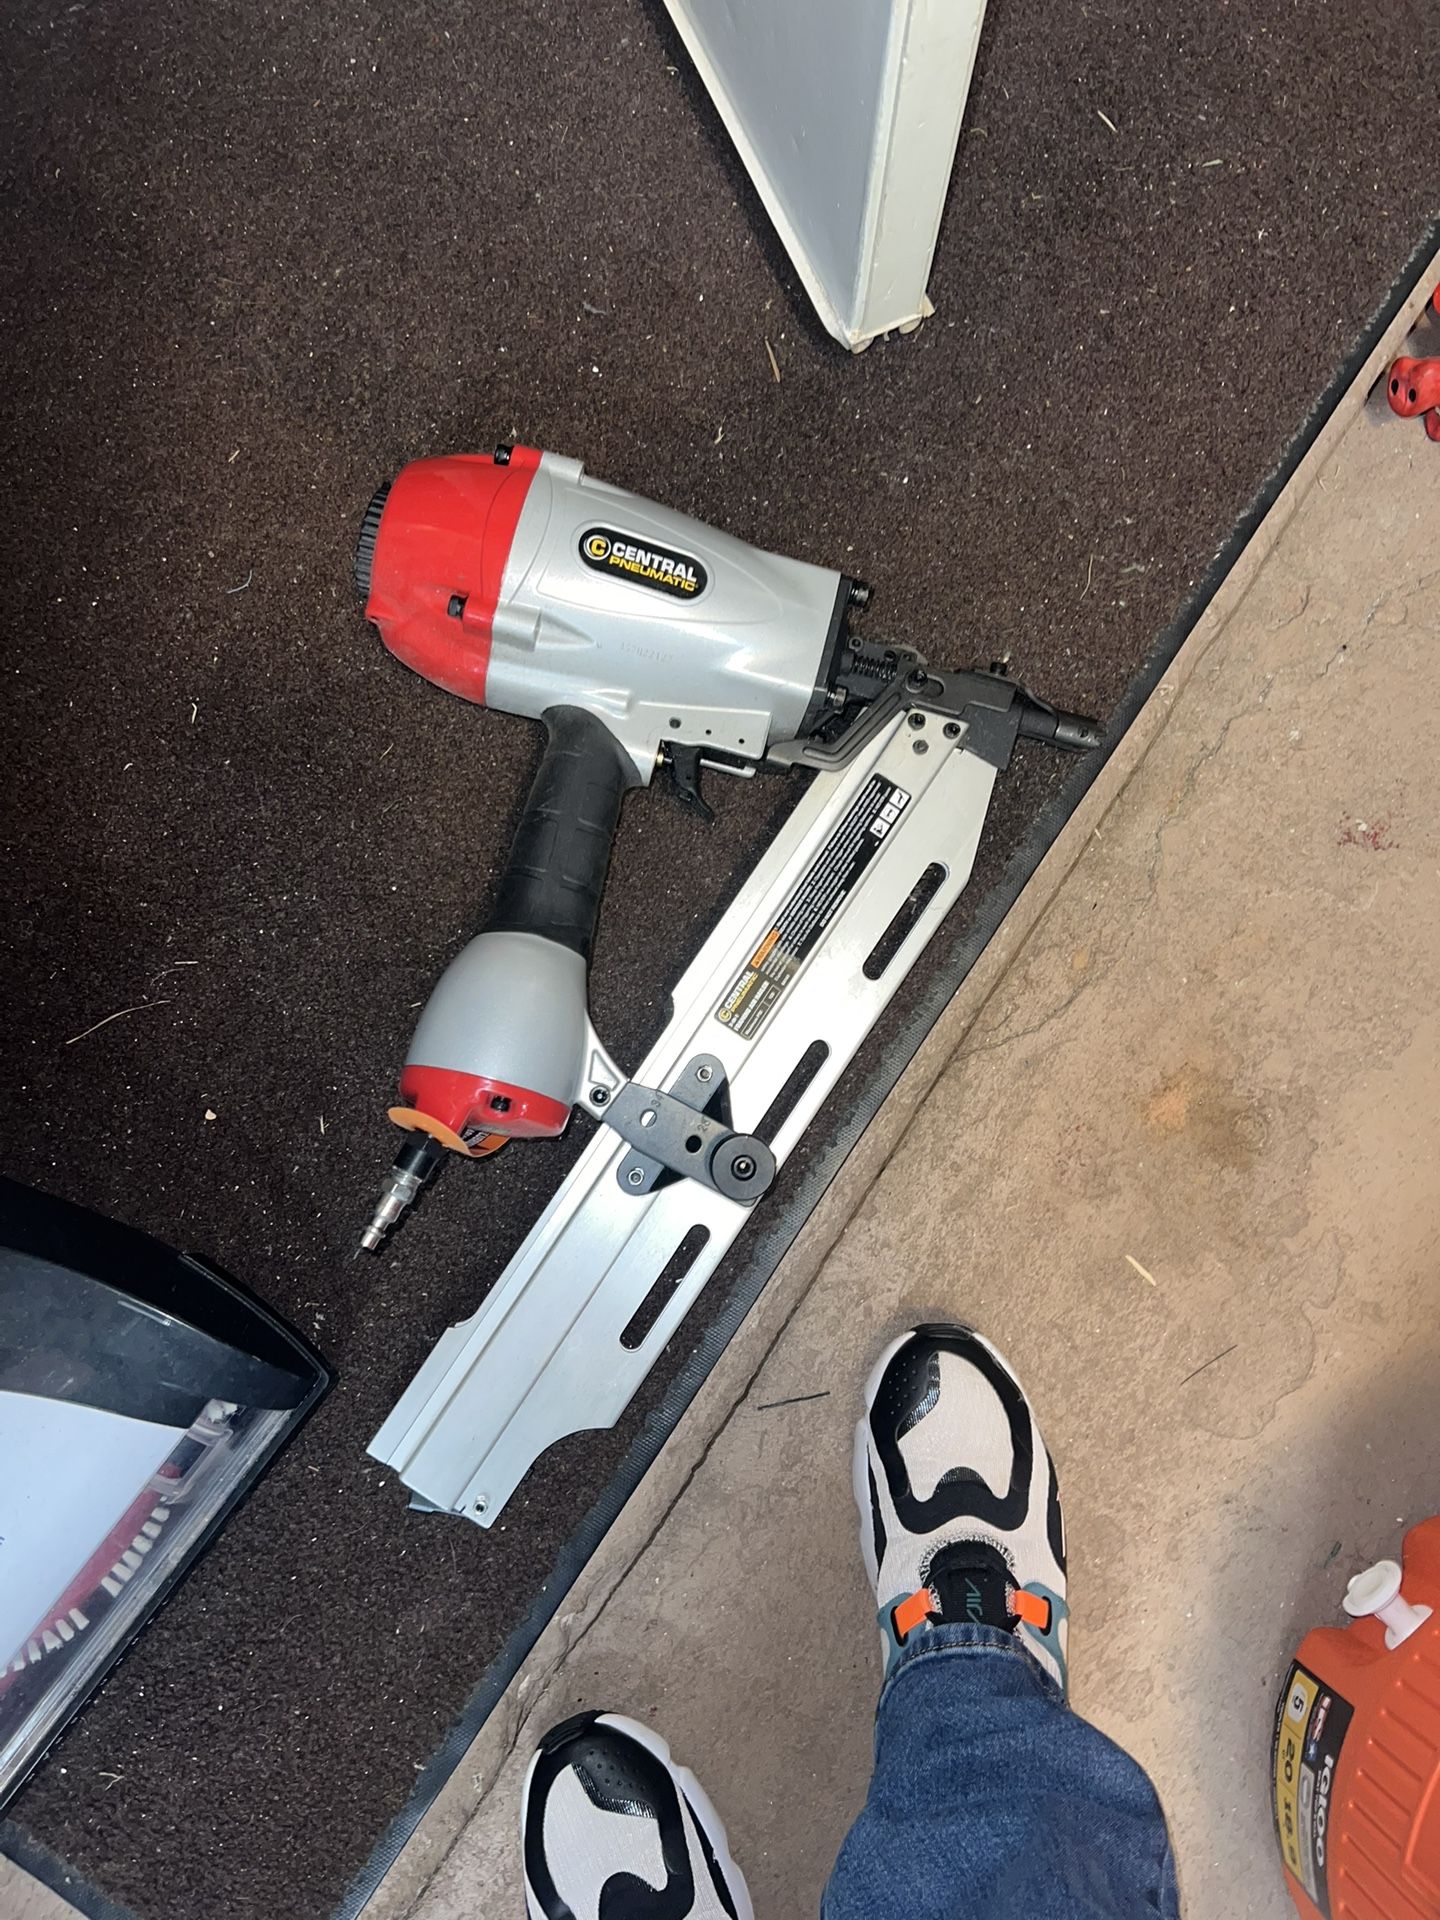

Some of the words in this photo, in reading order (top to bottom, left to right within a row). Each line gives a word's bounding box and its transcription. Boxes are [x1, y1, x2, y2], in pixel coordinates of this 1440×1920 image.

[609, 556, 696, 592] PNEUMATIC
[612, 542, 697, 582] CENTRAL
[724, 970, 755, 1009] CENTRAL
[1293, 1695, 1305, 1712] 5
[1284, 1737, 1296, 1783] 20
[1316, 1754, 1334, 1867] IGLOO
